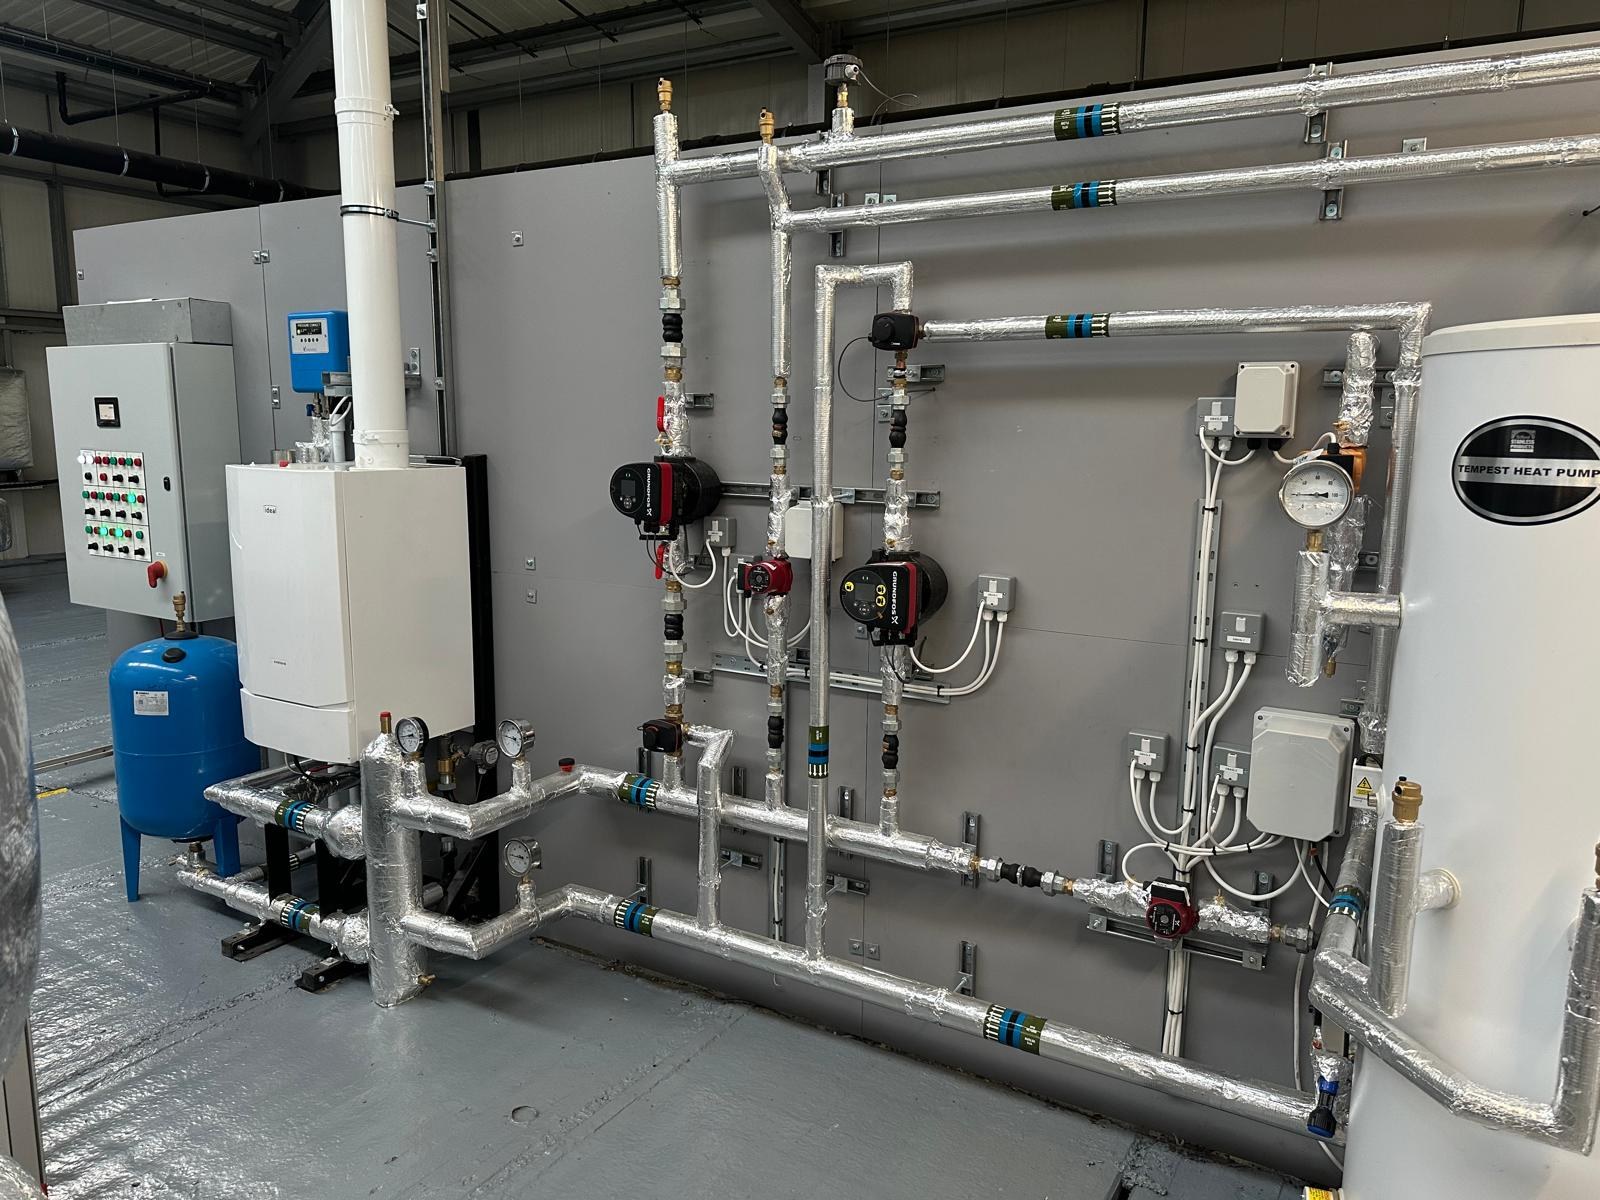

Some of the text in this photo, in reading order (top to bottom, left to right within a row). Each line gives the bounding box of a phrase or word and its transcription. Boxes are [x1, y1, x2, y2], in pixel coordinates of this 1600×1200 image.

[1458, 464, 1600, 478] TEMPEST HEAT PUMP
